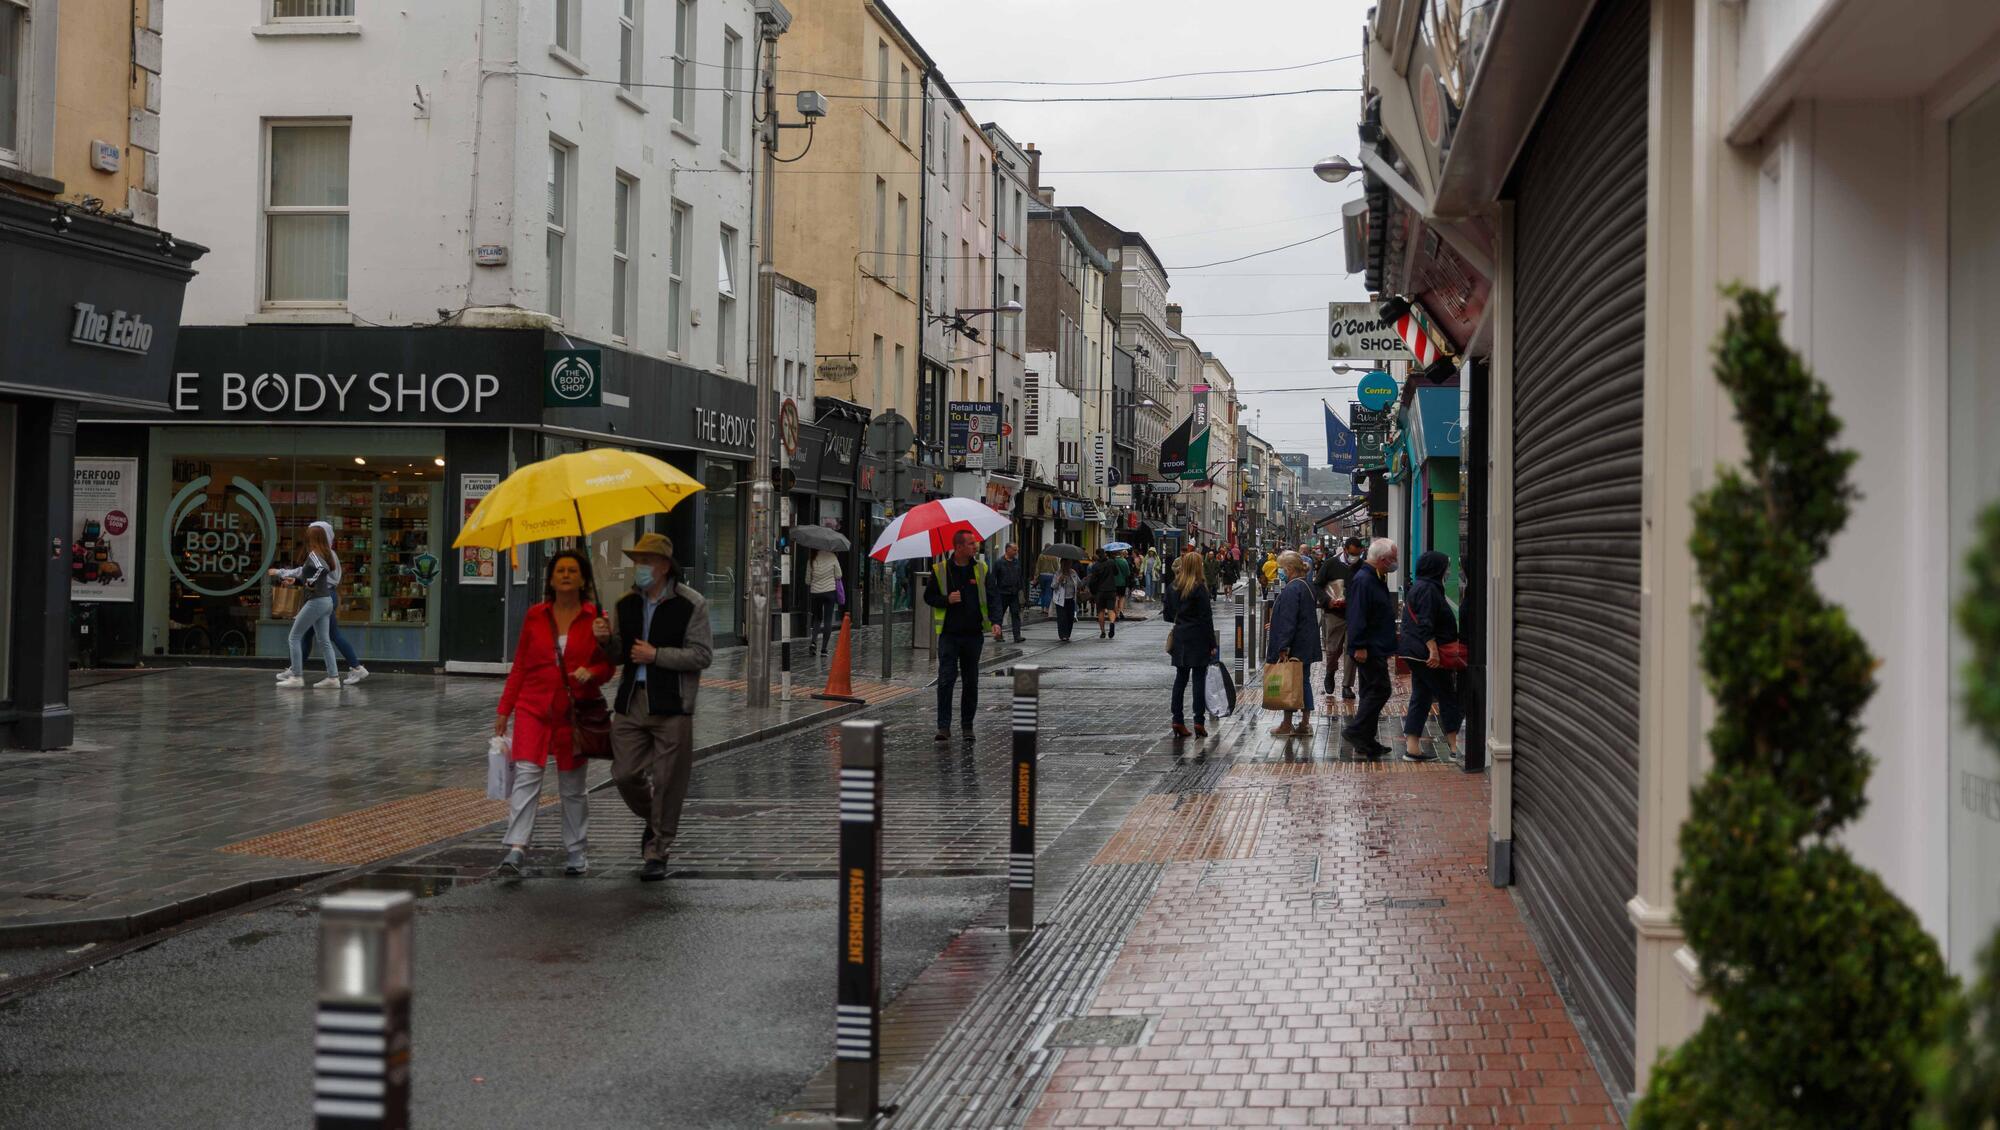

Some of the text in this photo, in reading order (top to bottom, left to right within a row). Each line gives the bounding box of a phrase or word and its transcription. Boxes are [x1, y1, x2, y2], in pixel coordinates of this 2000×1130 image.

[100, 144, 120, 159] HYLAND
[477, 248, 503, 256] HYLAND
[72, 301, 153, 352] The Echo
[559, 376, 586, 385] BODY
[565, 369, 580, 377] THE
[222, 371, 358, 412] BODY
[368, 371, 500, 413] SHOP
[560, 384, 585, 392] SHOP
[1364, 387, 1392, 395] Centra
[951, 403, 992, 411] Retail Unit
[950, 412, 962, 421] To
[695, 407, 717, 443] THE
[720, 412, 750, 448] BODY
[1094, 435, 1104, 486] FUJIFILM
[1162, 460, 1186, 468] TUDOR
[109, 520, 124, 529] SOON
[201, 512, 240, 530] THE
[186, 531, 256, 552] BODY
[188, 553, 251, 573] SHOP
[1019, 761, 1030, 827] #ASKCONSENT
[848, 867, 865, 965] #ASKCONSENT
